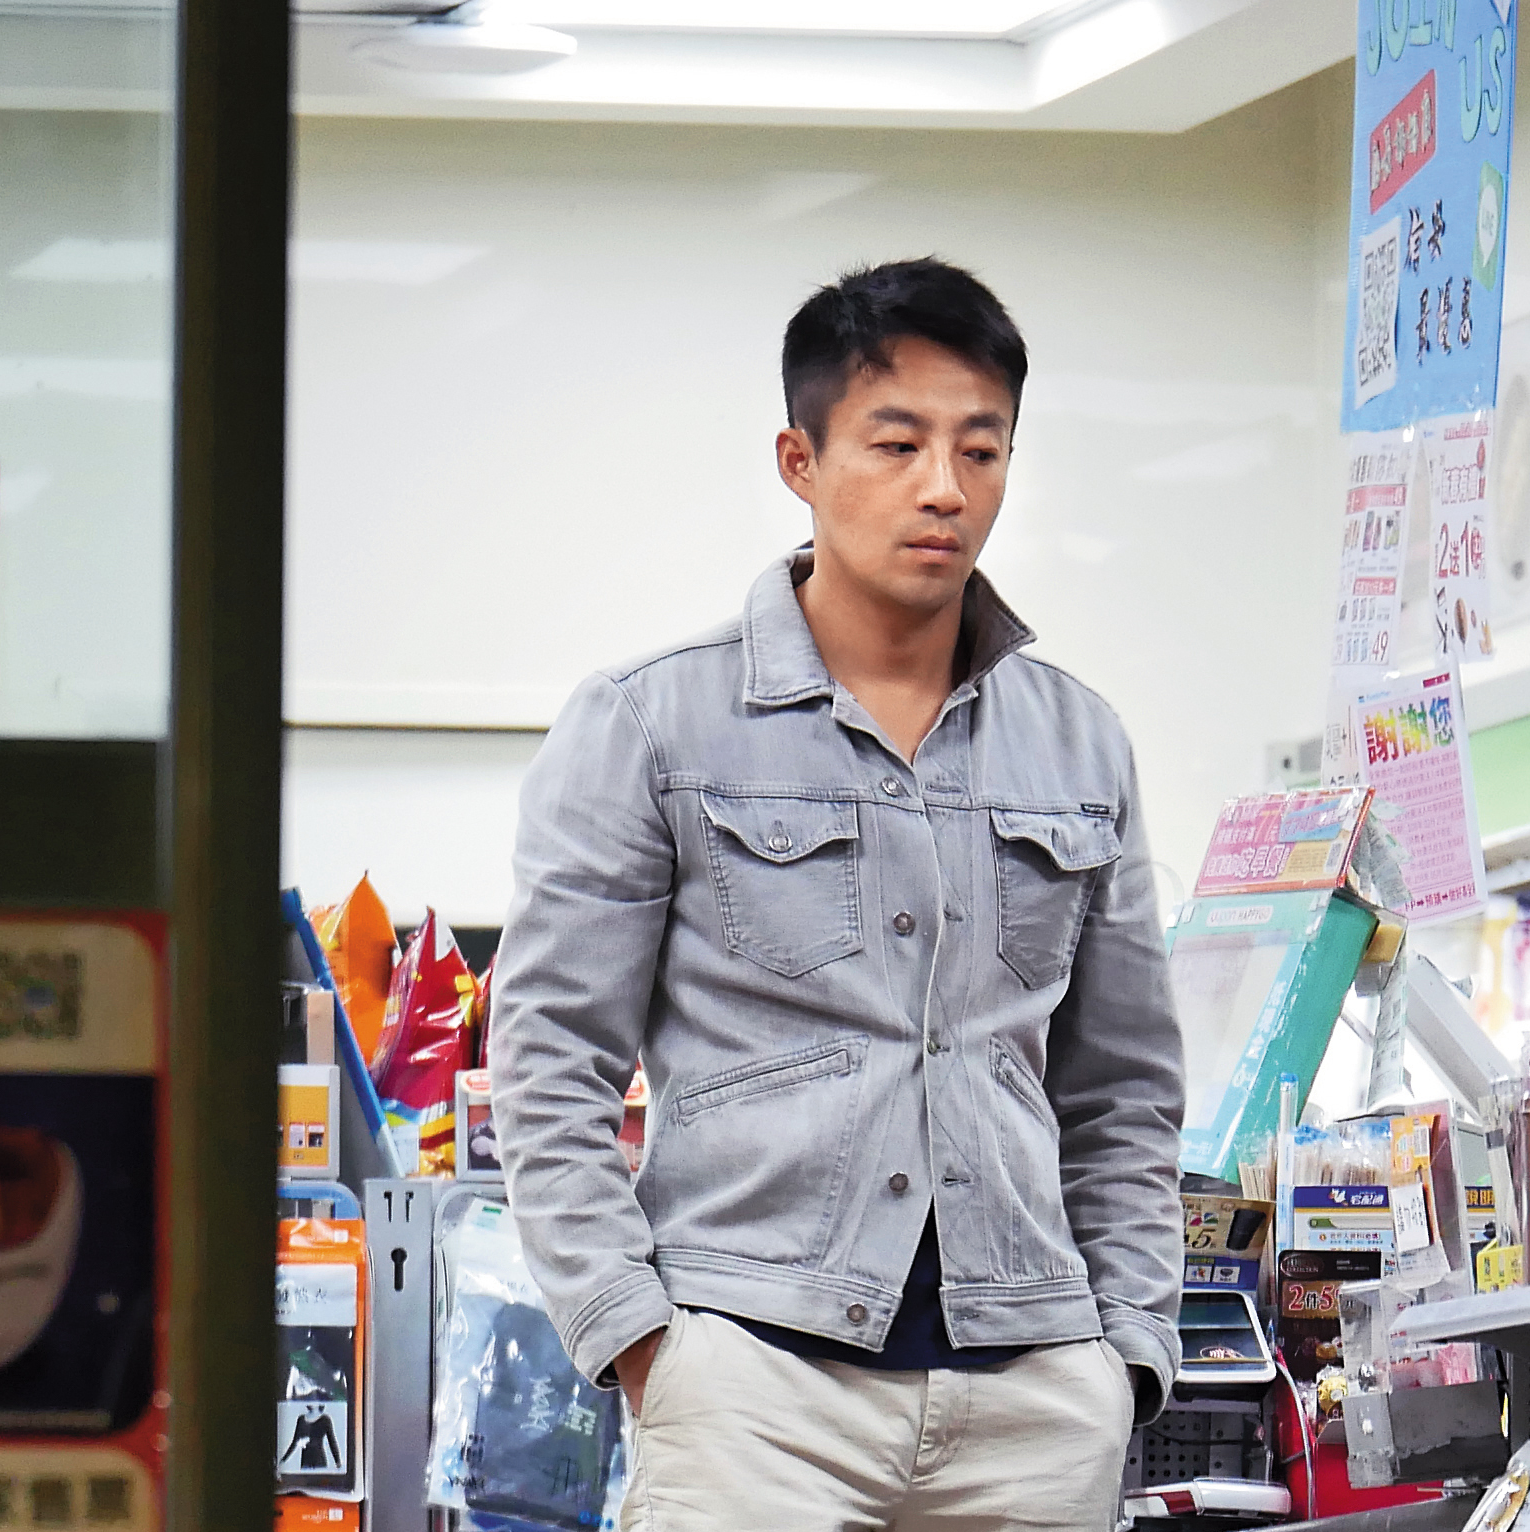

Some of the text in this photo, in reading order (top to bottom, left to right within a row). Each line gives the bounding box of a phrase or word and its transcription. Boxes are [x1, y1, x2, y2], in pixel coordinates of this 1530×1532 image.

[1459, 26, 1507, 143] US
[1364, 696, 1455, 765] 謝謝您
